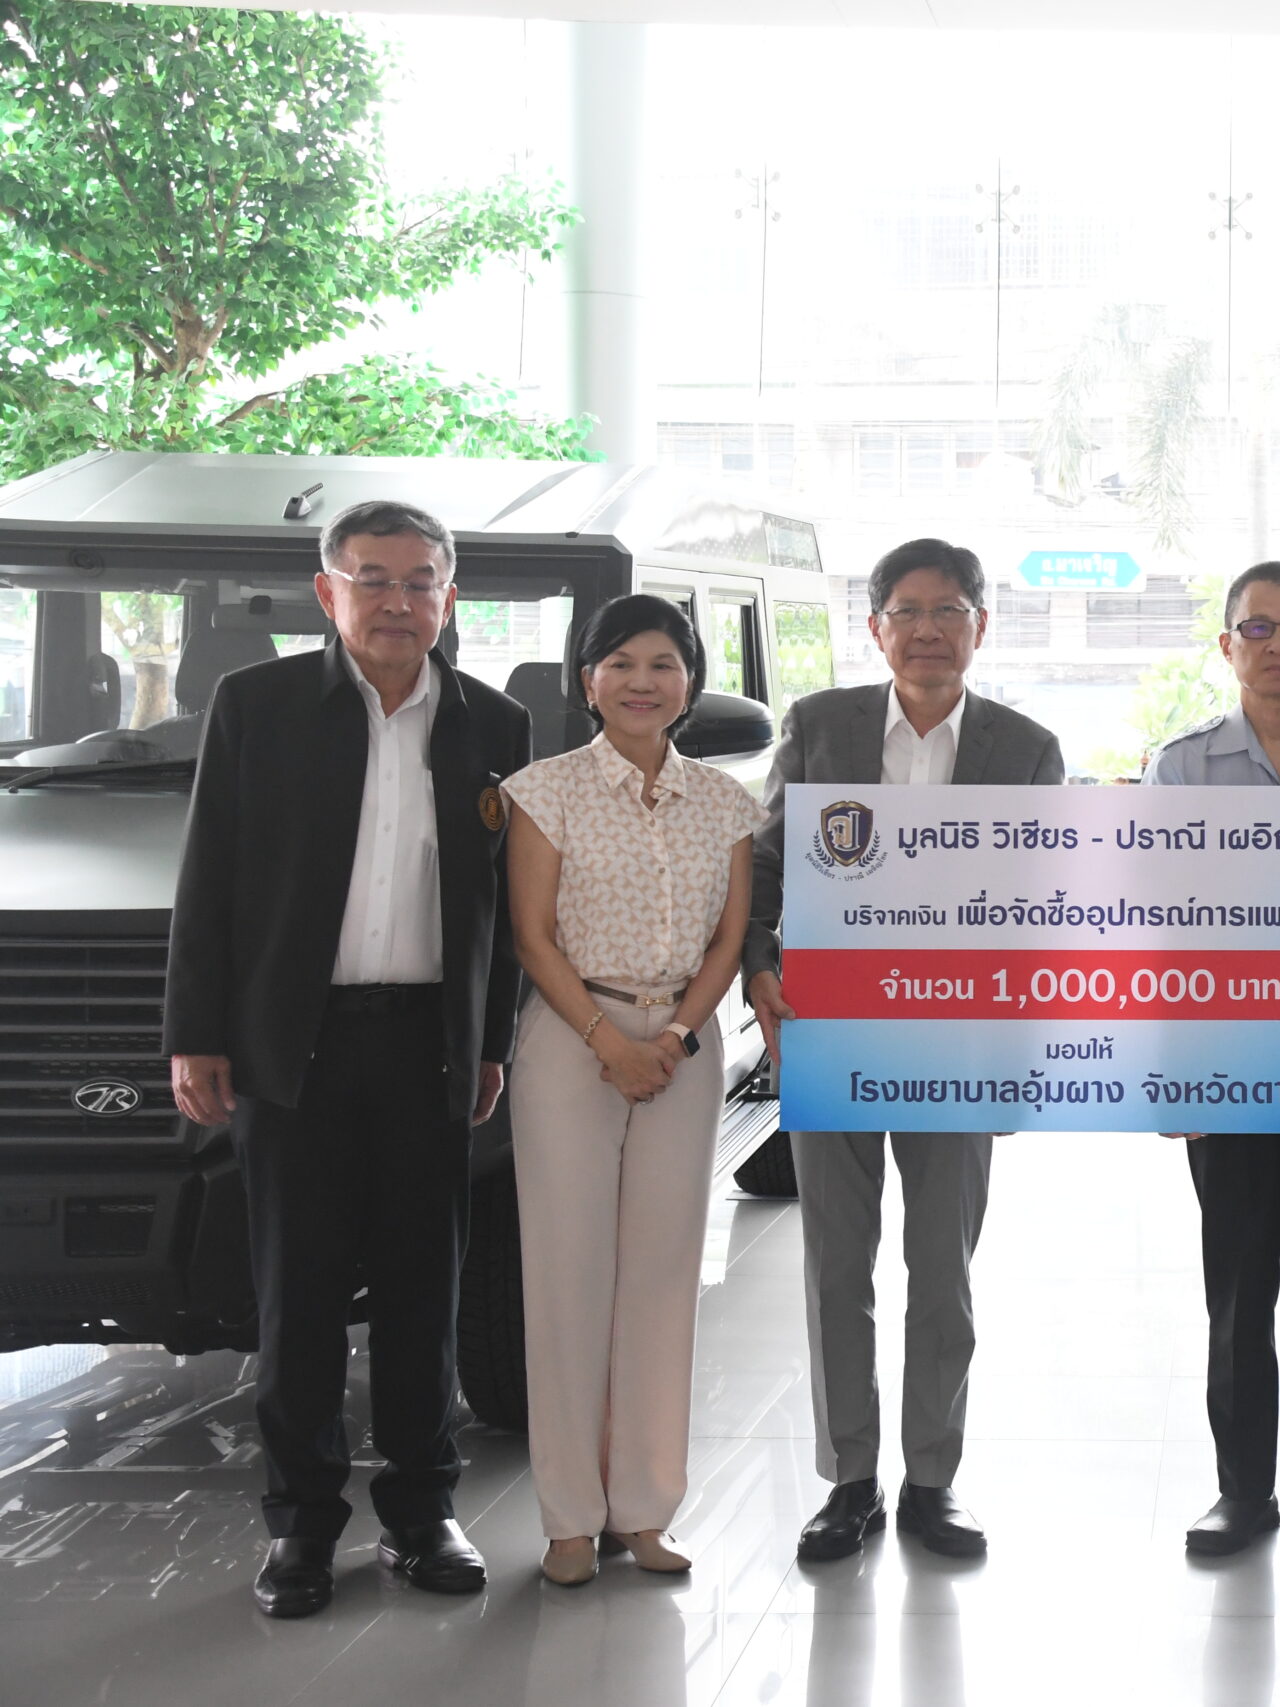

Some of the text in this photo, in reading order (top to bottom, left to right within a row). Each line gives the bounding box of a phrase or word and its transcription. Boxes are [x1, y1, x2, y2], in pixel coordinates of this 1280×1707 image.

[898, 820, 980, 859] มูลนิธิ
[992, 819, 1079, 850] วิเชียร
[1115, 819, 1207, 851] ปราณี
[843, 903, 947, 927] บริจาคเงิน
[878, 968, 974, 1001] จำนวน
[991, 968, 1216, 1010] 1,000,000
[1045, 1036, 1114, 1061] มอบให้
[849, 1069, 1126, 1113] โรงพยาบาลอุ้มผาง
